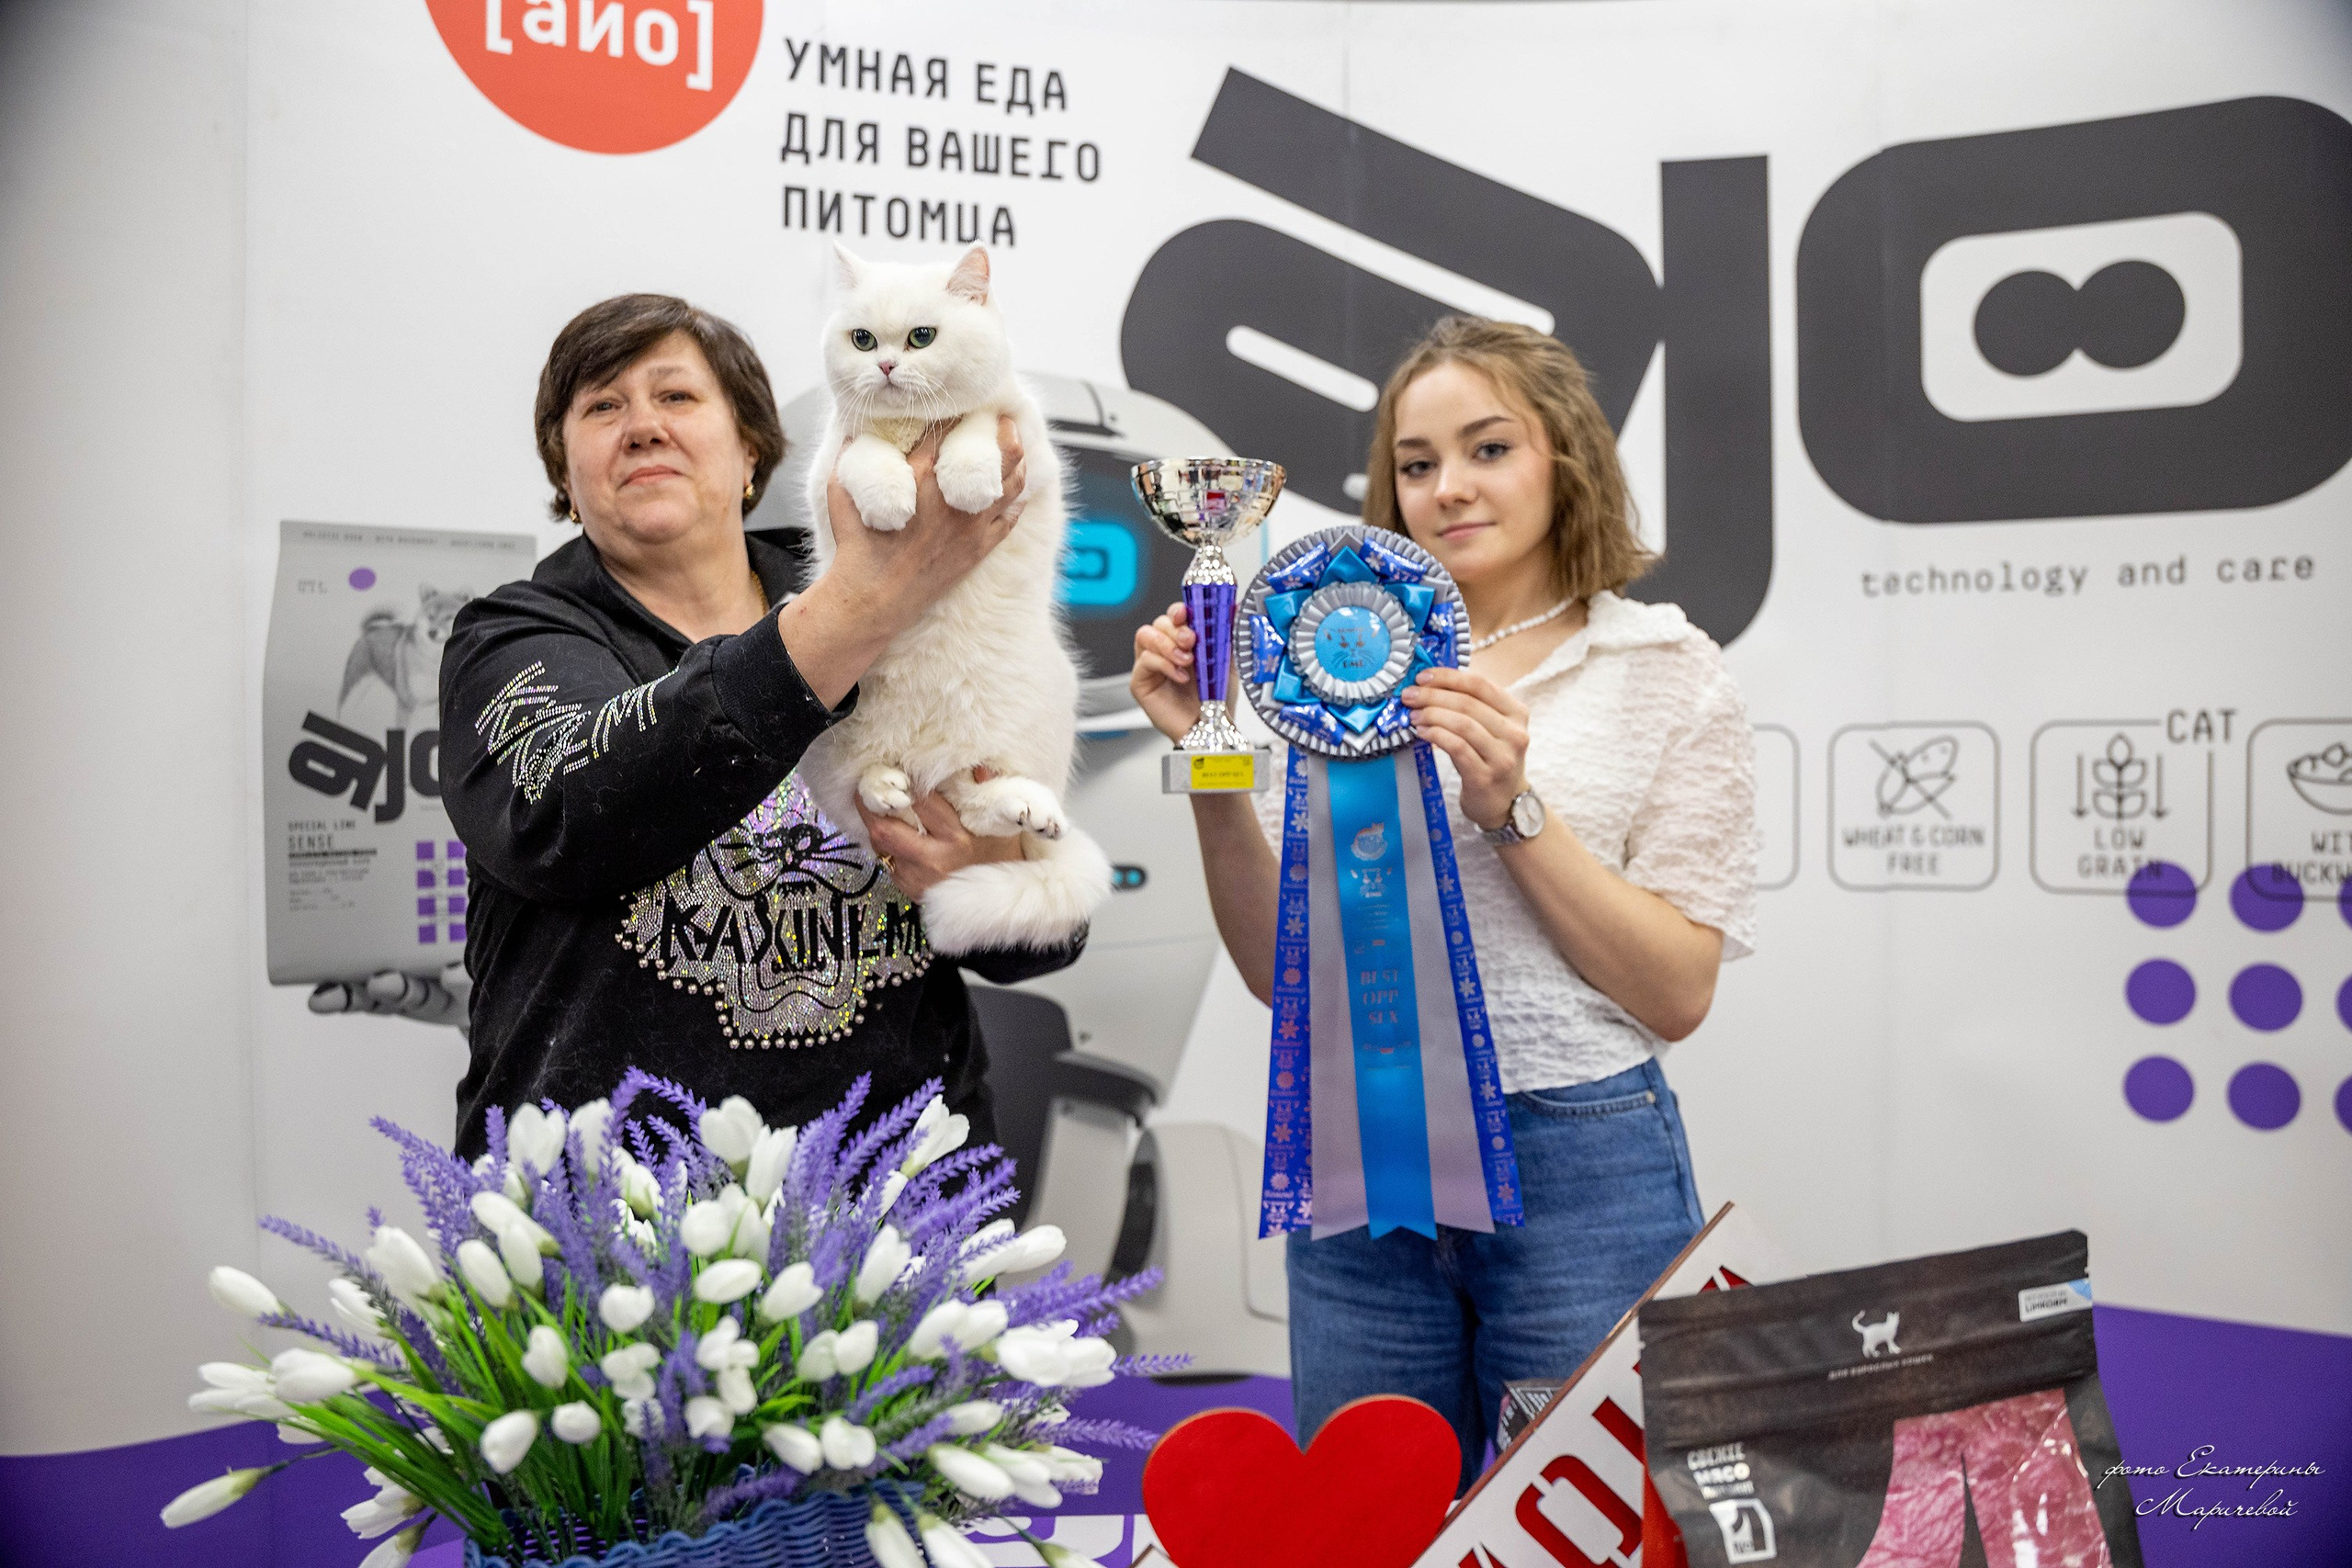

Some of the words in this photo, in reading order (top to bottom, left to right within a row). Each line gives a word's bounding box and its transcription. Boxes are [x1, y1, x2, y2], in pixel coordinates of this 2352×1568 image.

[786, 38, 947, 99] УМНАЯ
[977, 63, 1067, 117] ЕДА
[781, 112, 878, 165] ДЛЯ
[908, 127, 1100, 182] ВАШЕГО
[784, 186, 1015, 246] ПИТОМЦА
[1860, 561, 2089, 597] technology
[2117, 555, 2188, 587] and
[2216, 554, 2316, 583] care
[2166, 709, 2238, 743] CAT
[1843, 827, 1905, 848] WHEAT
[1930, 825, 1984, 847] CORN
[2094, 828, 2146, 851] LOW
[1887, 852, 1939, 875] FREE
[2077, 855, 2164, 879] GRAIN
